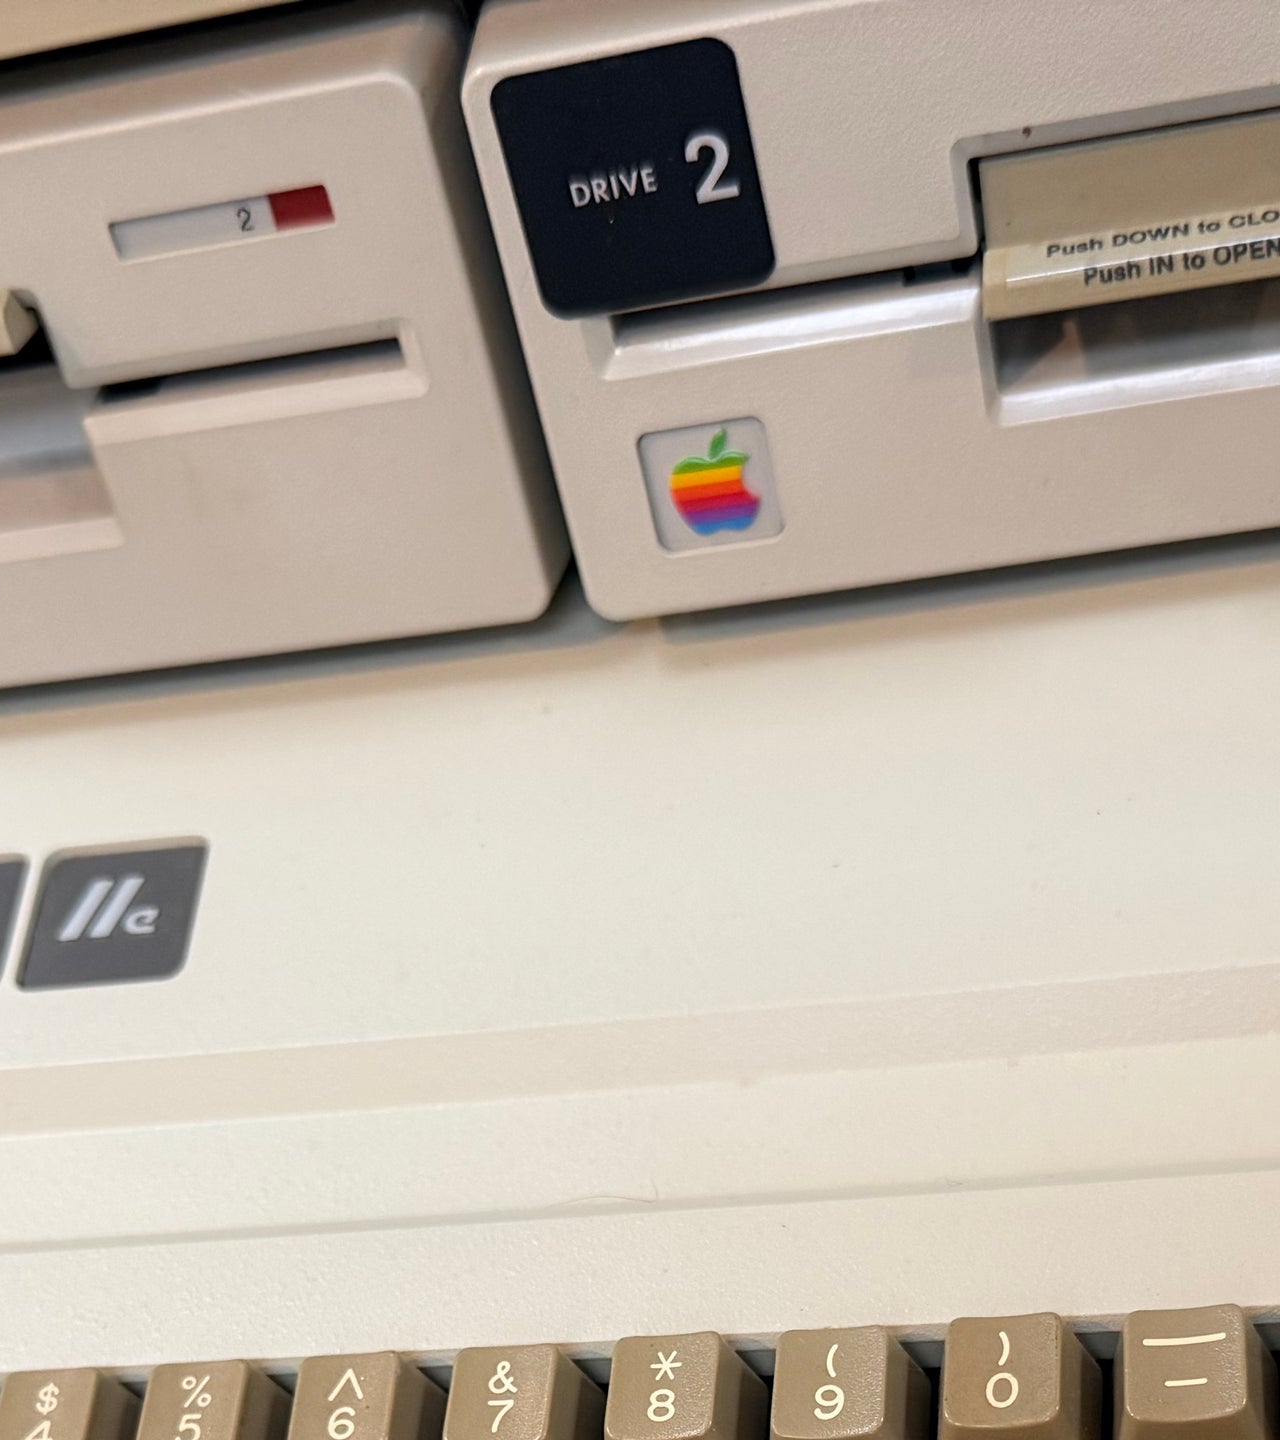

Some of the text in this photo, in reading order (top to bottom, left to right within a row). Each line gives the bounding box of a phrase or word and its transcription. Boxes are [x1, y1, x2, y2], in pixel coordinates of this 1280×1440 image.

[570, 134, 740, 208] DRIVE 2
[237, 207, 255, 232] 2
[1046, 238, 1103, 258] Push
[1112, 223, 1189, 245] DOWN
[1198, 219, 1221, 234] to
[1083, 255, 1141, 287] Push
[1148, 253, 1175, 276] IN
[1183, 252, 1206, 271] to
[181, 1375, 212, 1409] %
[487, 1360, 518, 1395] &
[35, 1382, 61, 1416] $
[486, 1398, 515, 1434] 7
[646, 1388, 676, 1423] 8
[813, 1384, 845, 1421] 9
[326, 1406, 357, 1440] 6
